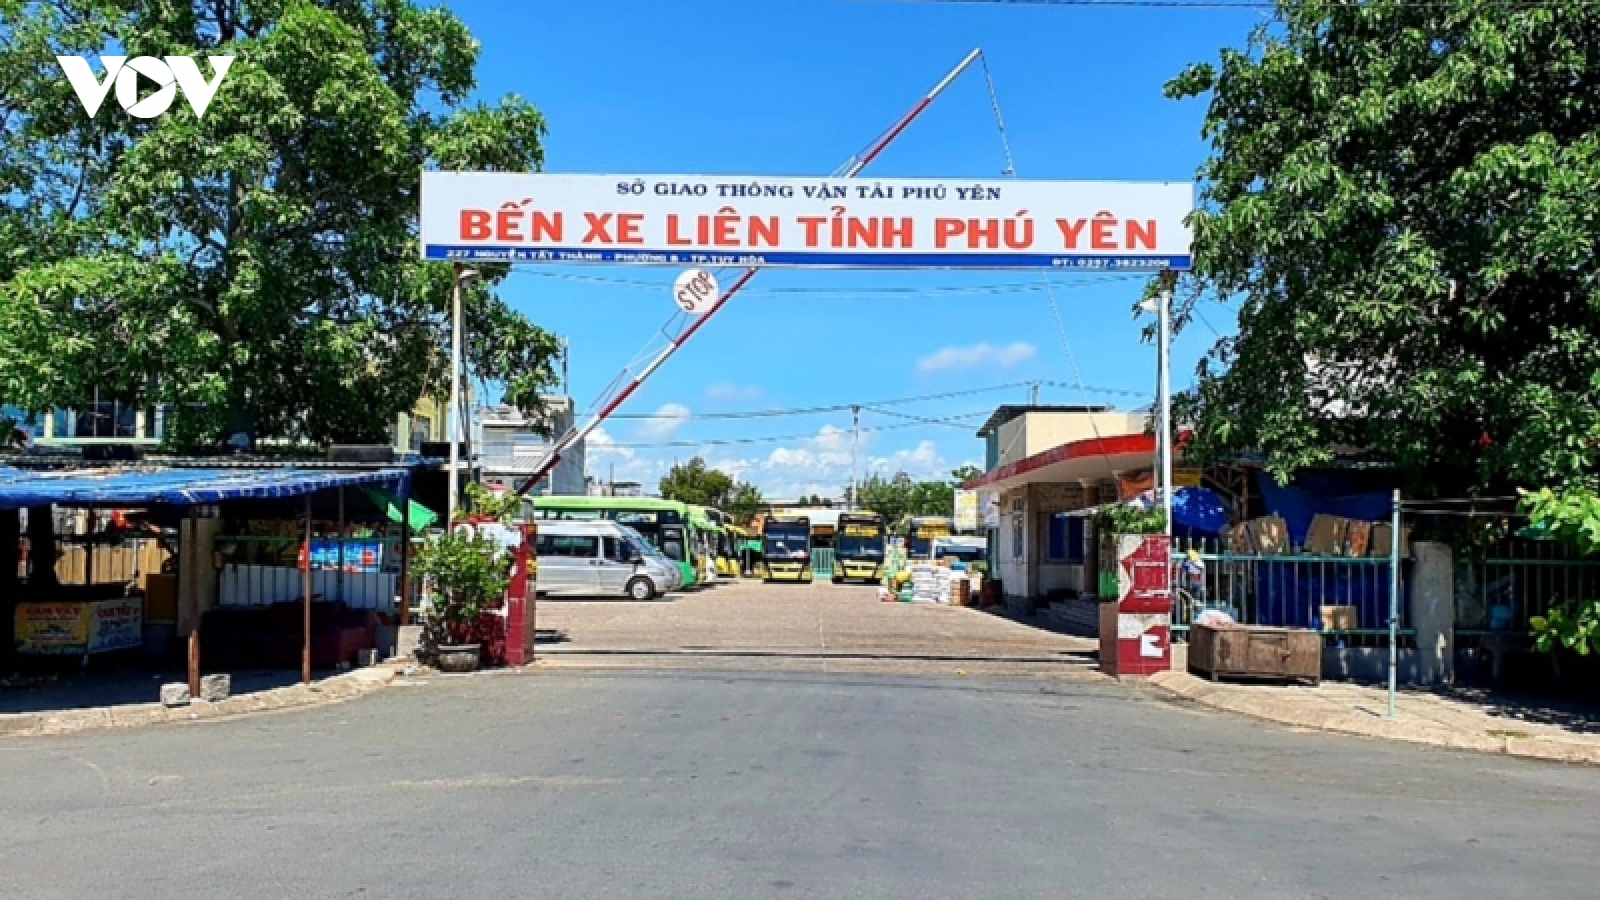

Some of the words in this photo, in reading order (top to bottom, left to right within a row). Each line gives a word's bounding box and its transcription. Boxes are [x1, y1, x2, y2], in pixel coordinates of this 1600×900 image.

[617, 177, 646, 196] SỞ
[654, 181, 709, 196] GIAO
[715, 180, 795, 199] THÔNG
[802, 181, 848, 202] VẬN
[856, 181, 894, 199] TẢI
[902, 183, 948, 201] PHÚ
[955, 183, 1002, 201] YÊN
[459, 198, 564, 244] BẾN
[582, 212, 645, 245] XE
[666, 205, 781, 248] LIÊN
[796, 205, 914, 249] TỈNH
[934, 209, 1034, 250] PHÚ
[1056, 209, 1157, 251] YÊN
[677, 271, 715, 311] STOP
